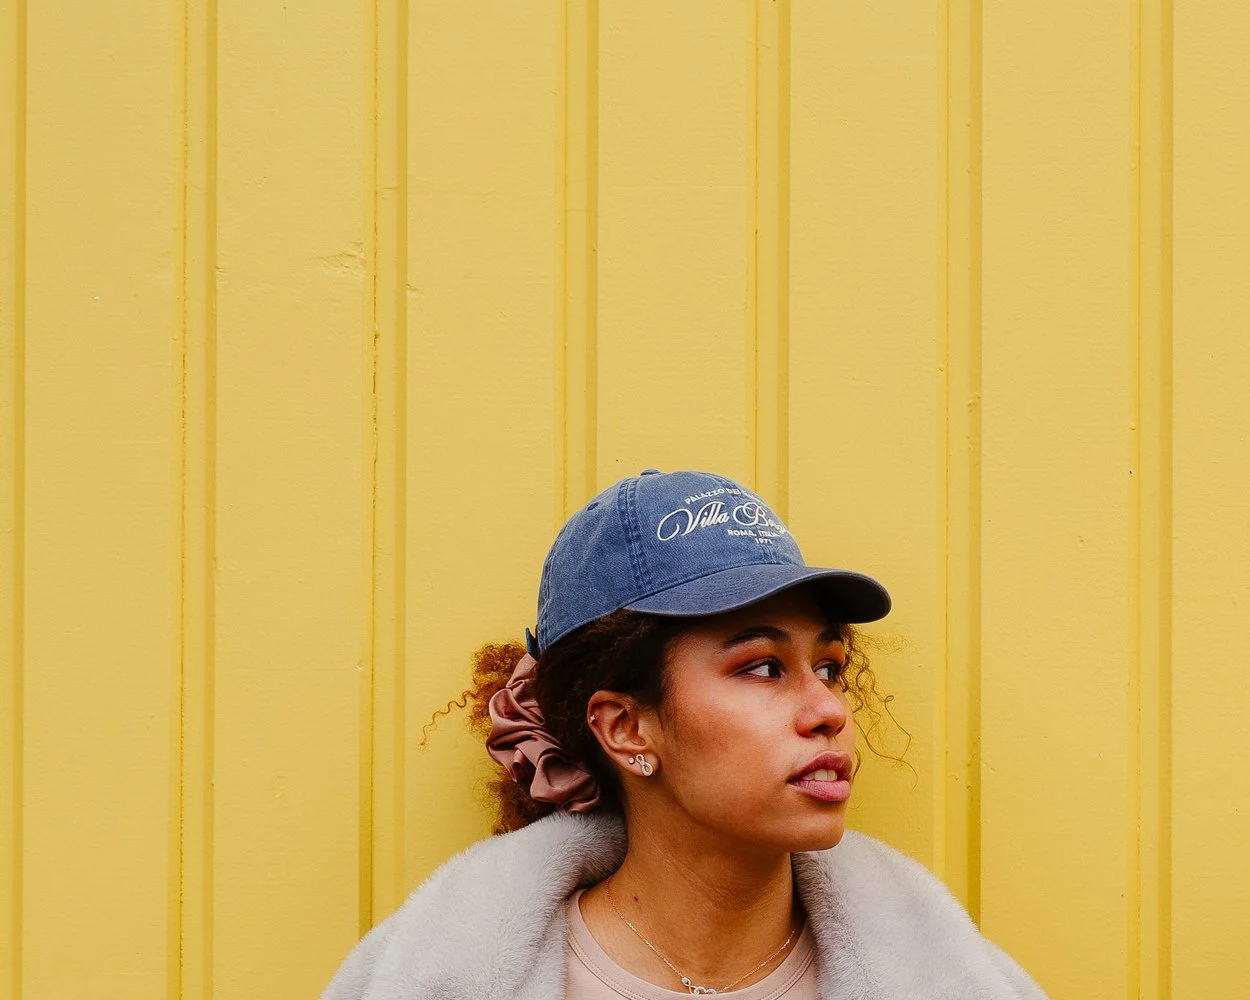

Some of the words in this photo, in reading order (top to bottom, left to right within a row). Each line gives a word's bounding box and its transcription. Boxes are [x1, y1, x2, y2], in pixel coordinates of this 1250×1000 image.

[684, 488, 725, 505] PALAZZO
[657, 501, 729, 541] Villa
[754, 537, 773, 545] 1971
